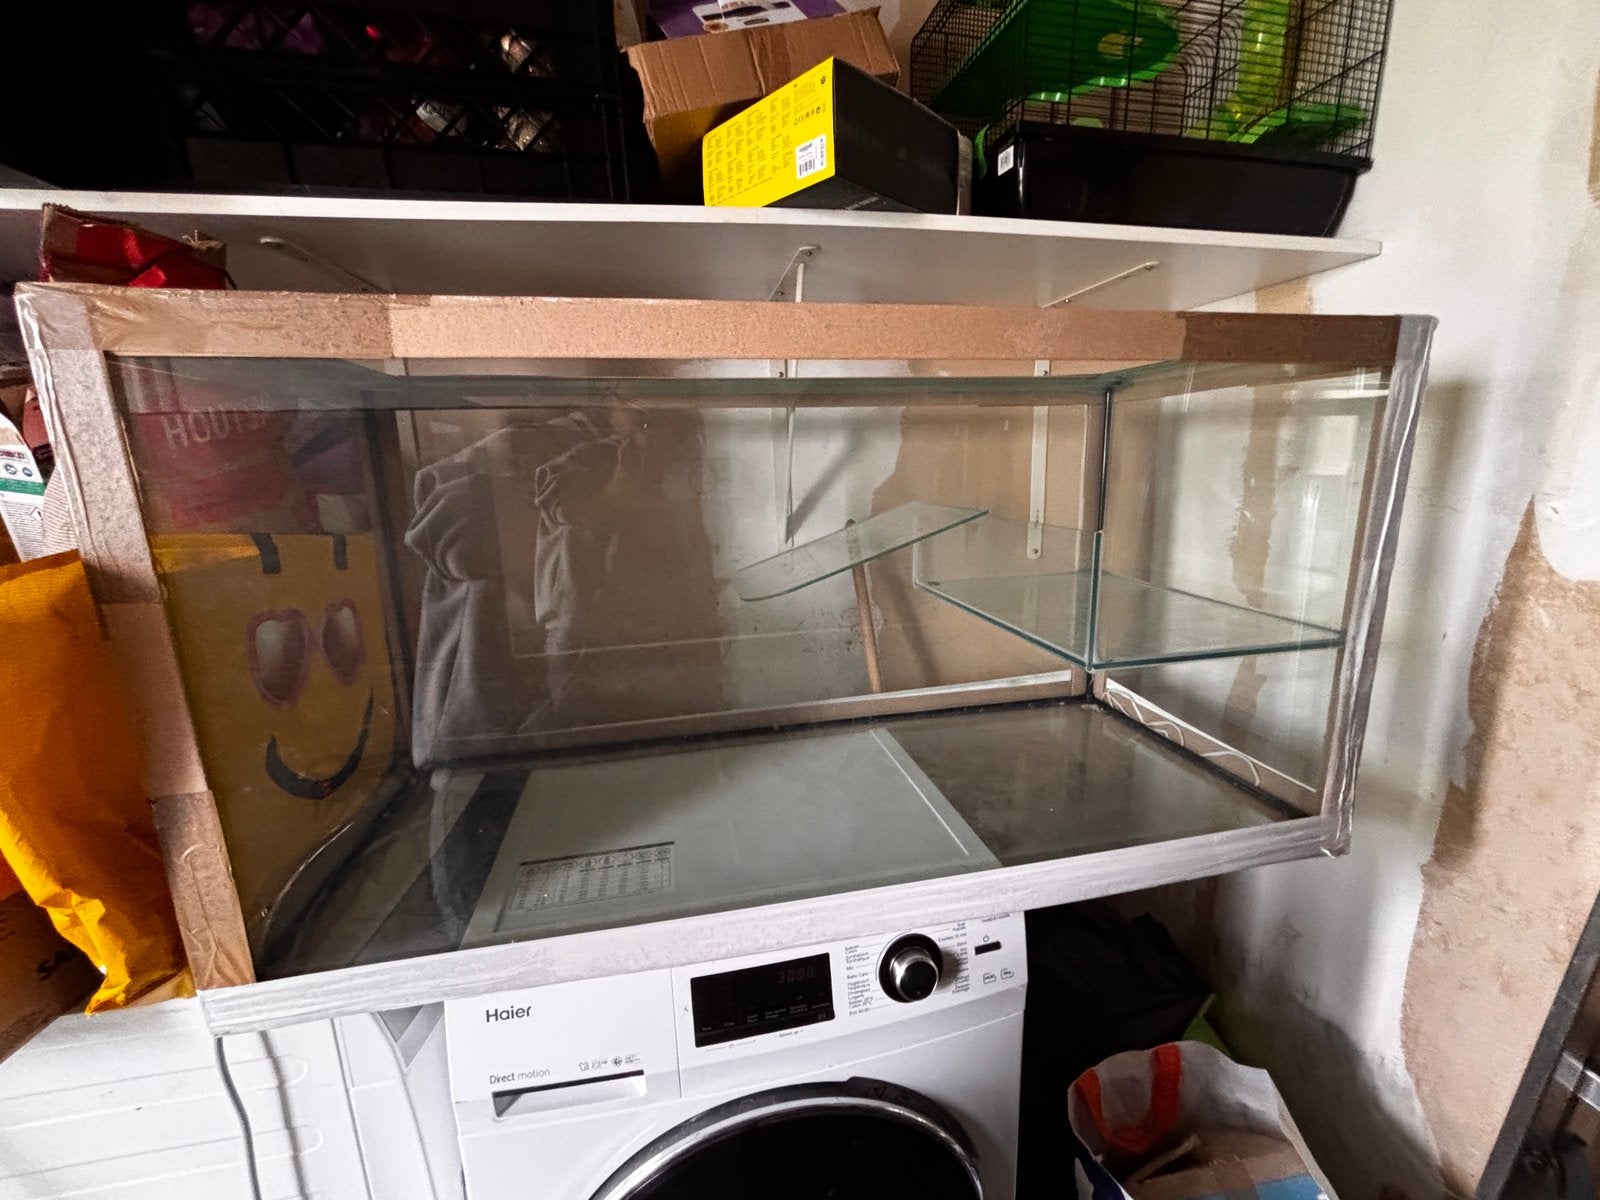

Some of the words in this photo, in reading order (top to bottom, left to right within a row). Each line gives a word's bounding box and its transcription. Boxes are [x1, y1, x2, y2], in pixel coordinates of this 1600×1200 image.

[486, 1005, 532, 1023] Haier
[489, 1073, 516, 1085] Direct
[517, 1068, 551, 1081] motion
